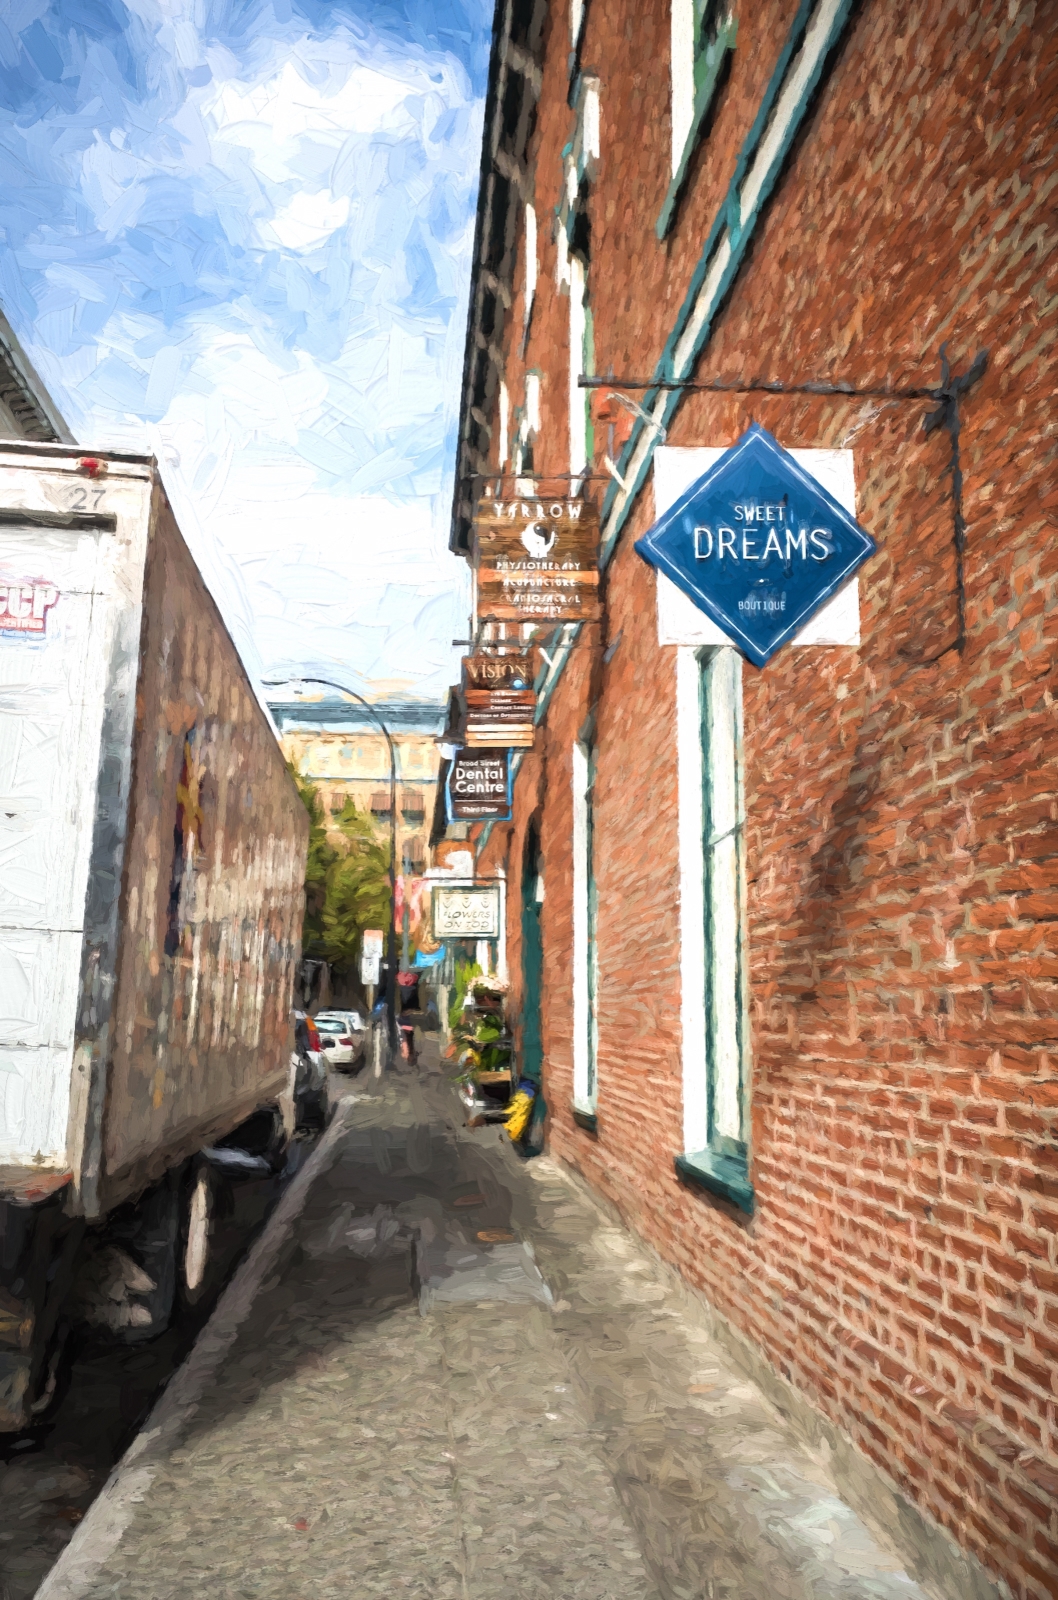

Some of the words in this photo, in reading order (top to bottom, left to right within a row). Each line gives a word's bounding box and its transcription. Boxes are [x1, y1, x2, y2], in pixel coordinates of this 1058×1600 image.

[72, 487, 107, 510] 27
[493, 502, 582, 519] YARROW
[734, 505, 787, 522] SWEET
[693, 526, 830, 561] DREAMS
[496, 561, 581, 571] PHYSIOTHERAPY
[502, 578, 577, 587] ACUPUNCTURE
[737, 600, 787, 611] BOUTIQUE
[468, 664, 528, 679] VISION
[455, 767, 504, 780] Dental
[455, 780, 504, 793] Centre
